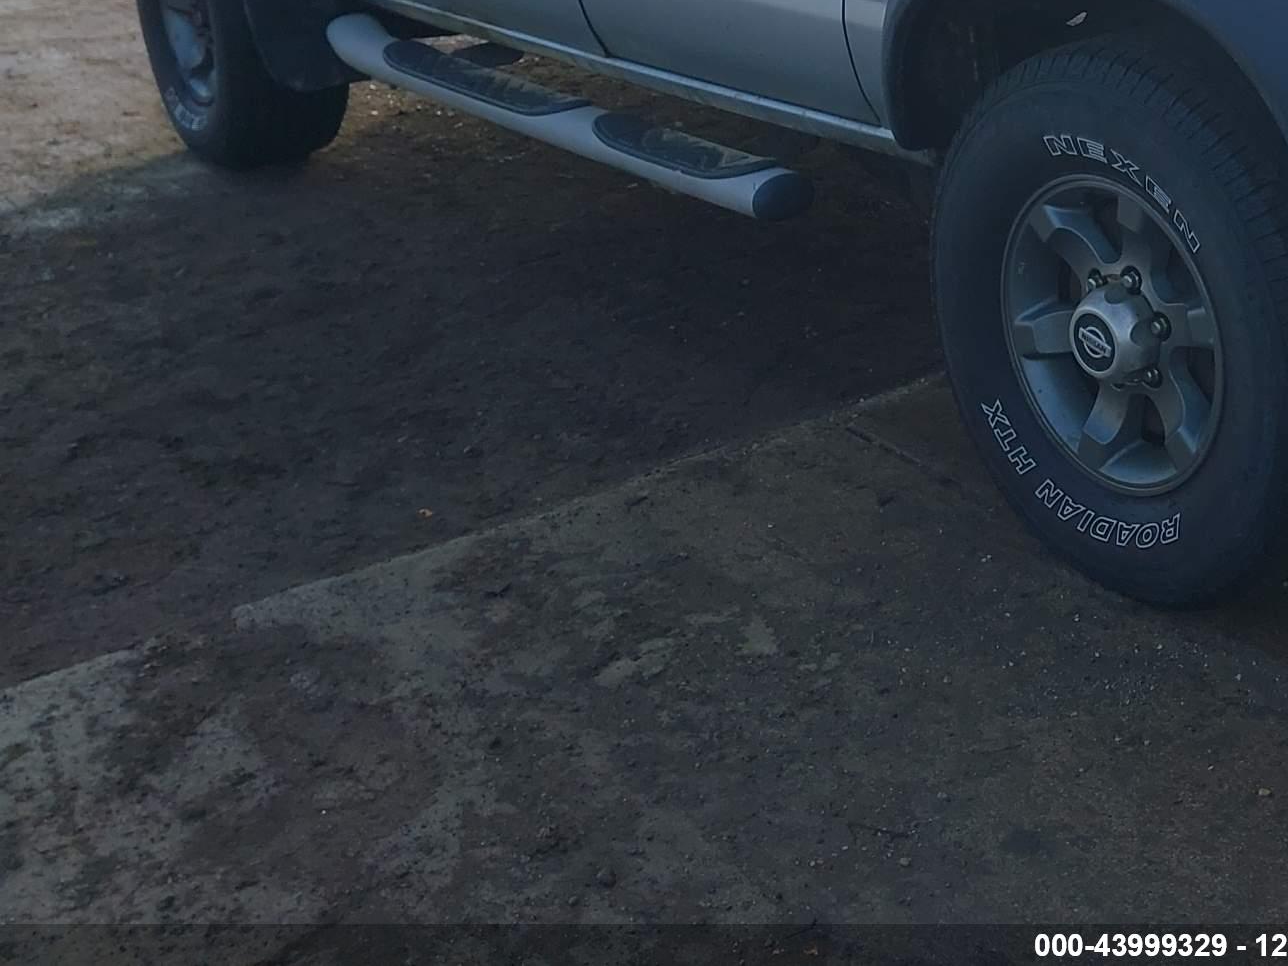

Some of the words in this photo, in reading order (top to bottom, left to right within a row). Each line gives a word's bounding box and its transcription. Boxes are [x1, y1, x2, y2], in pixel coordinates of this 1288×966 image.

[1043, 134, 1201, 253] NEXEN
[981, 399, 1037, 475] HTX
[1035, 479, 1181, 549] ROADIAN
